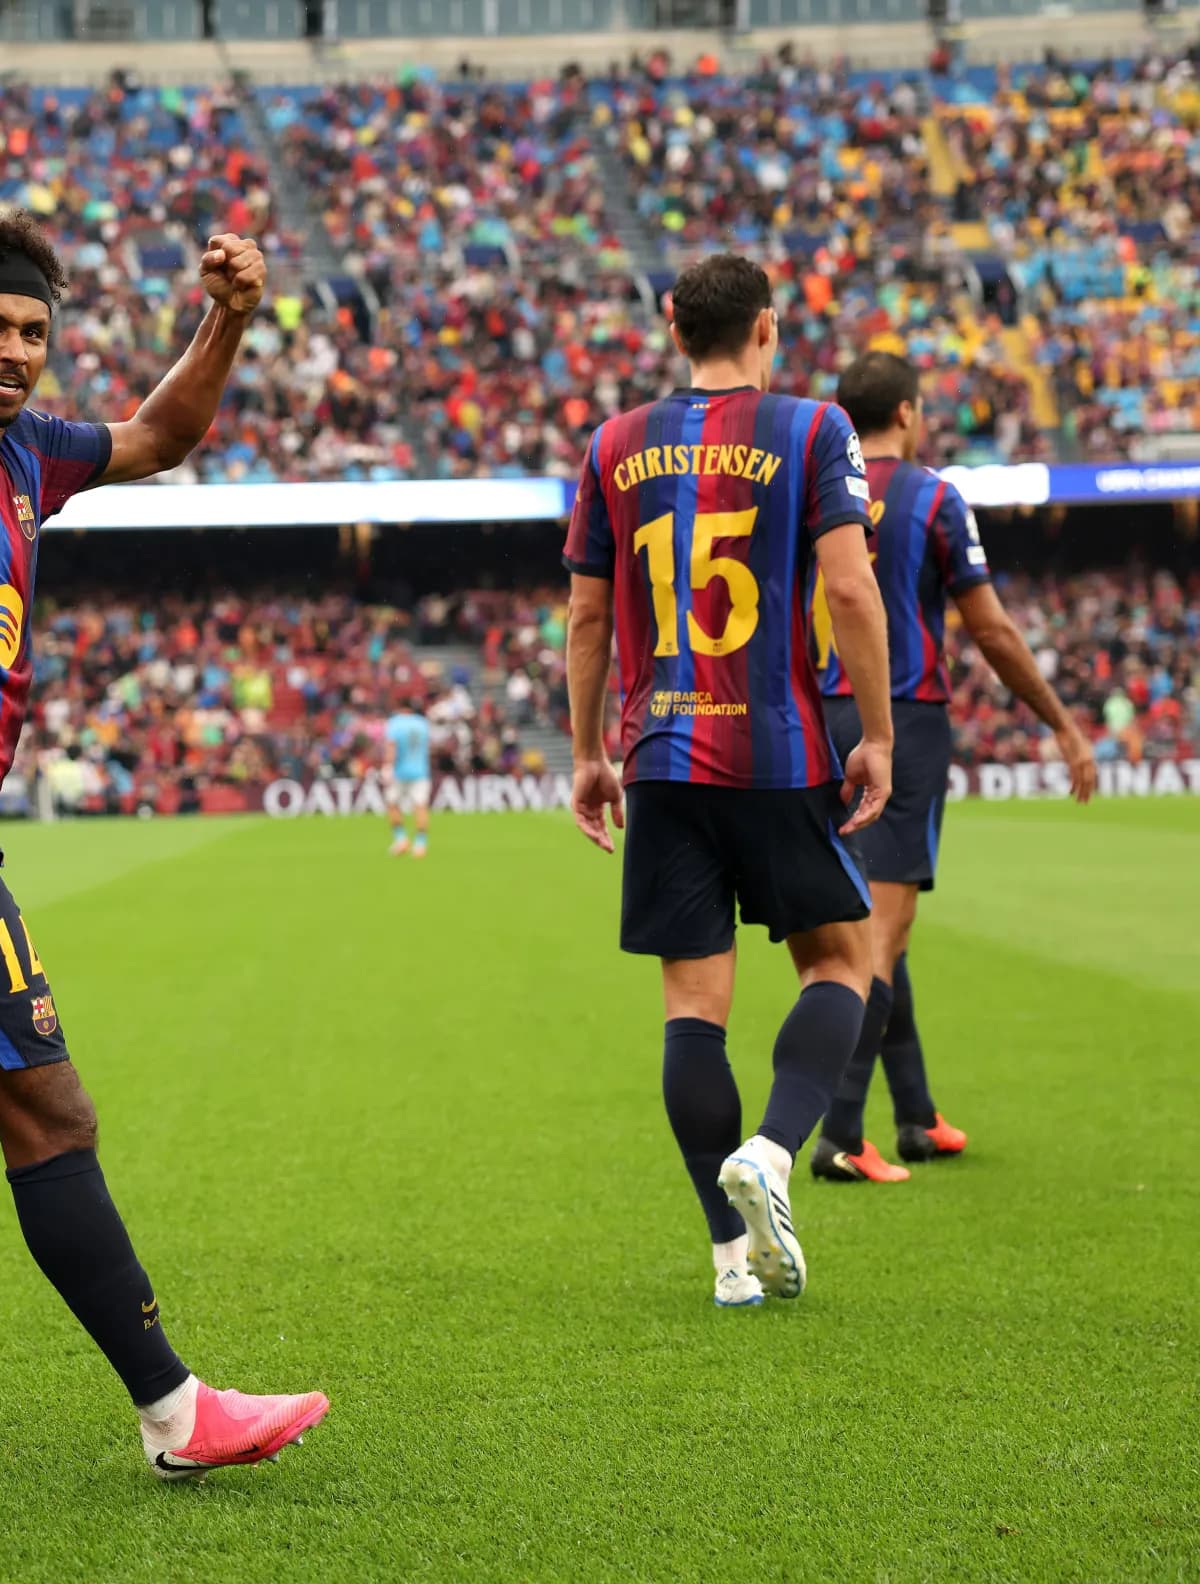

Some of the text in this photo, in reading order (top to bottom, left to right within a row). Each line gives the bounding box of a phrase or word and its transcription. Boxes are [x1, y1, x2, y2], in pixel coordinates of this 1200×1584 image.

[614, 444, 782, 492] CHRISTENSEN
[634, 506, 760, 657] 15
[673, 703, 747, 716] FOUNDATION
[264, 773, 573, 818] QATA AIRWA
[979, 759, 1200, 801] DESINAT
